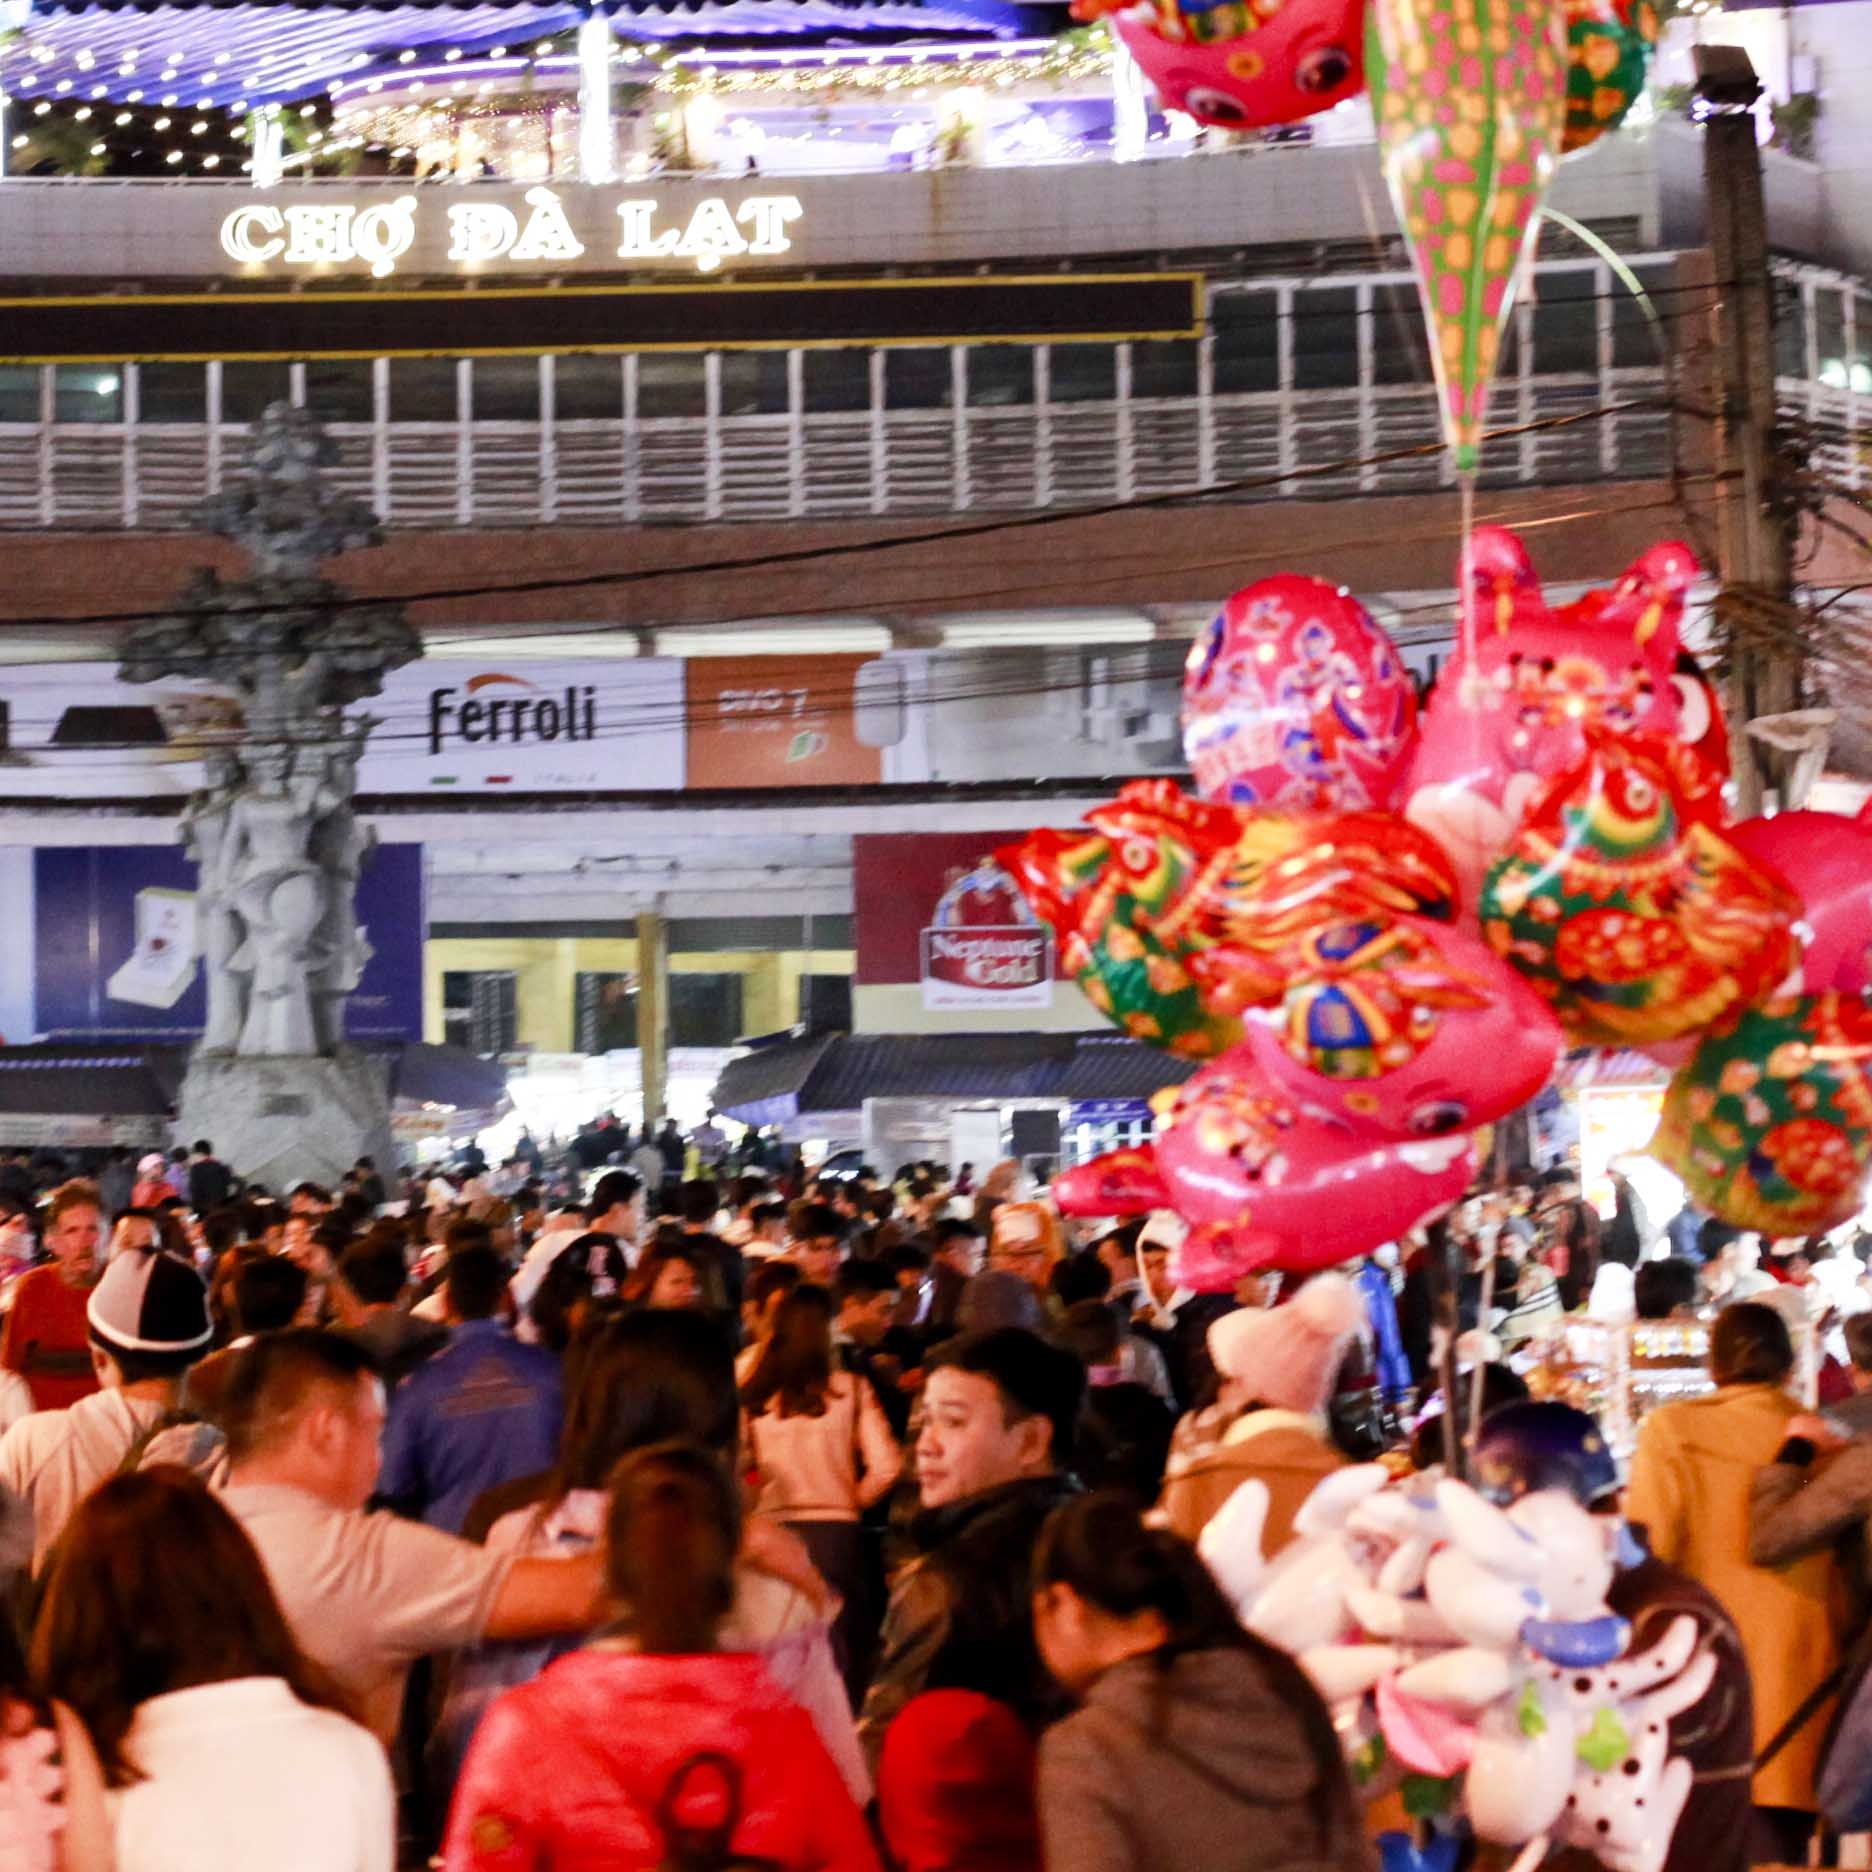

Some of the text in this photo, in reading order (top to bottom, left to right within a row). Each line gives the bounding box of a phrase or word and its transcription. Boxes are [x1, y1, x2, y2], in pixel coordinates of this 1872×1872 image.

[220, 187, 803, 278] CHỢ ĐÀ LẠT
[428, 686, 596, 755] Ferroli
[931, 933, 1044, 960] Neptune
[965, 956, 1039, 985] Gold
